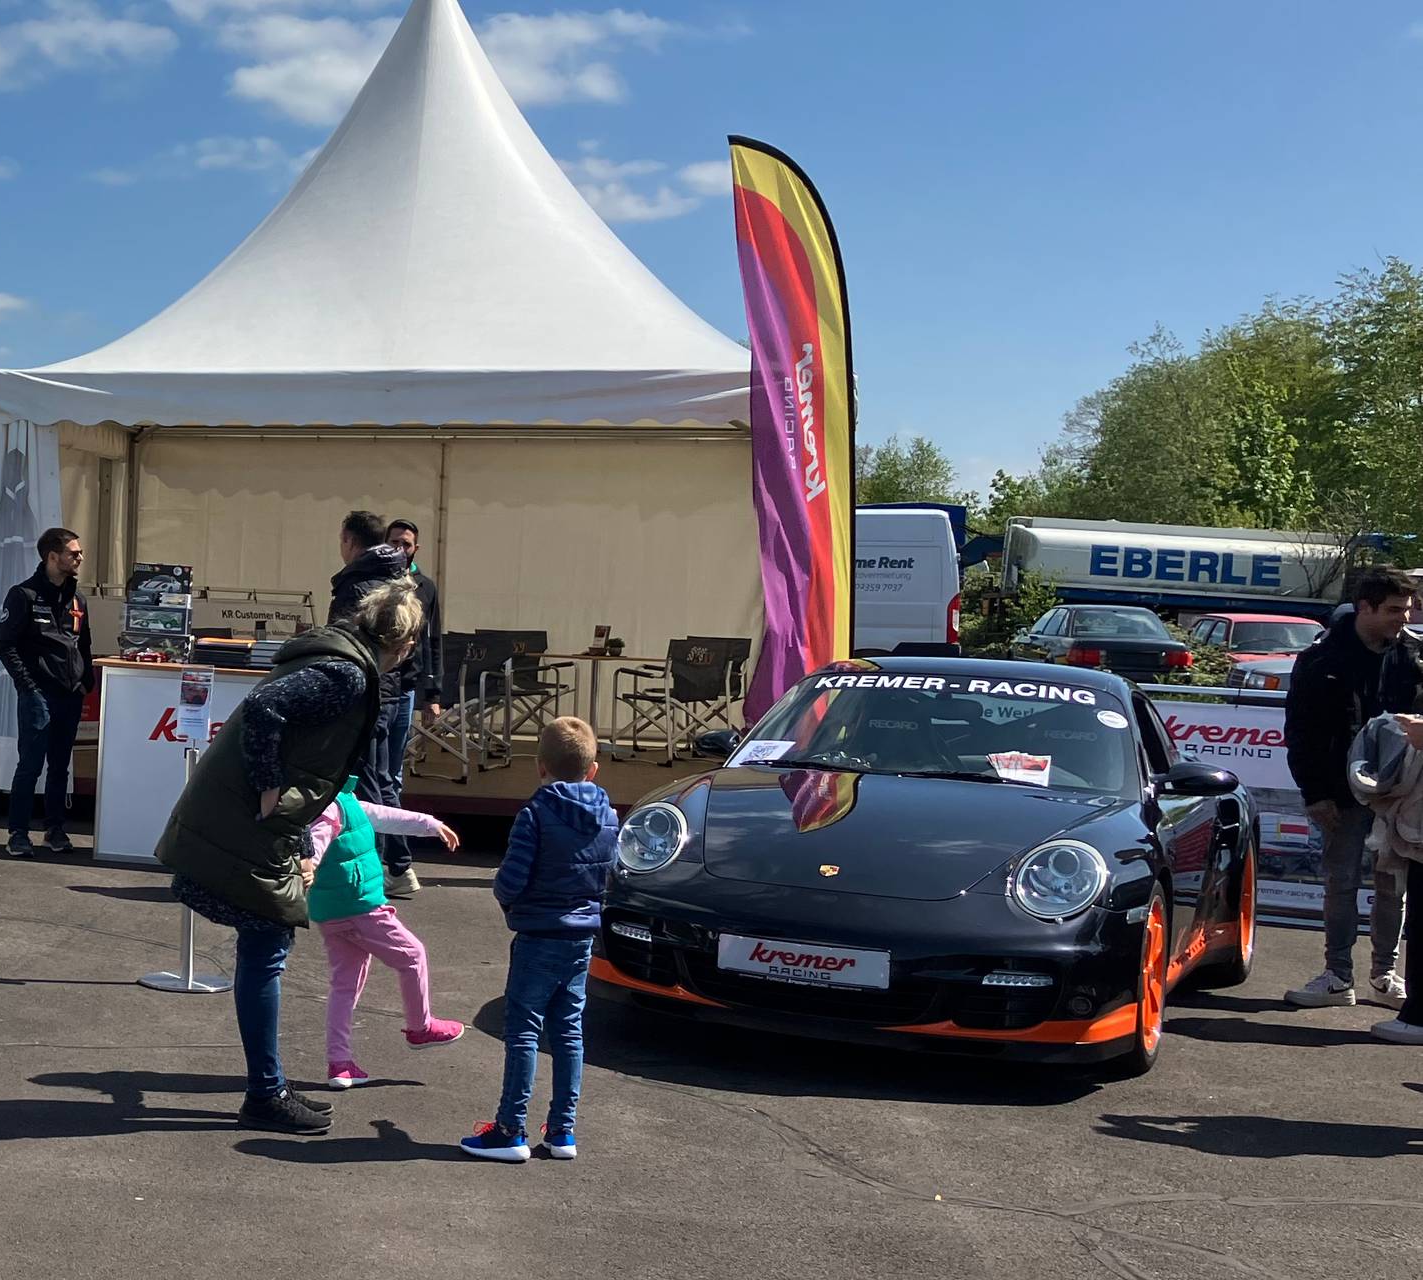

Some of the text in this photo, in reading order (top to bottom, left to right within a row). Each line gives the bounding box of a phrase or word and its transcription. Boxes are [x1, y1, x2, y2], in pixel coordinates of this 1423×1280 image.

[855, 556, 915, 569] me Rent
[1089, 544, 1282, 587] EBERLE
[221, 609, 302, 622] KR Customer Racing
[814, 675, 944, 691] KREMER
[968, 679, 1097, 706] RACING
[1165, 715, 1288, 748] kreme
[1184, 743, 1272, 759] RACING
[748, 942, 856, 972] kremer
[768, 965, 832, 981] RACING
